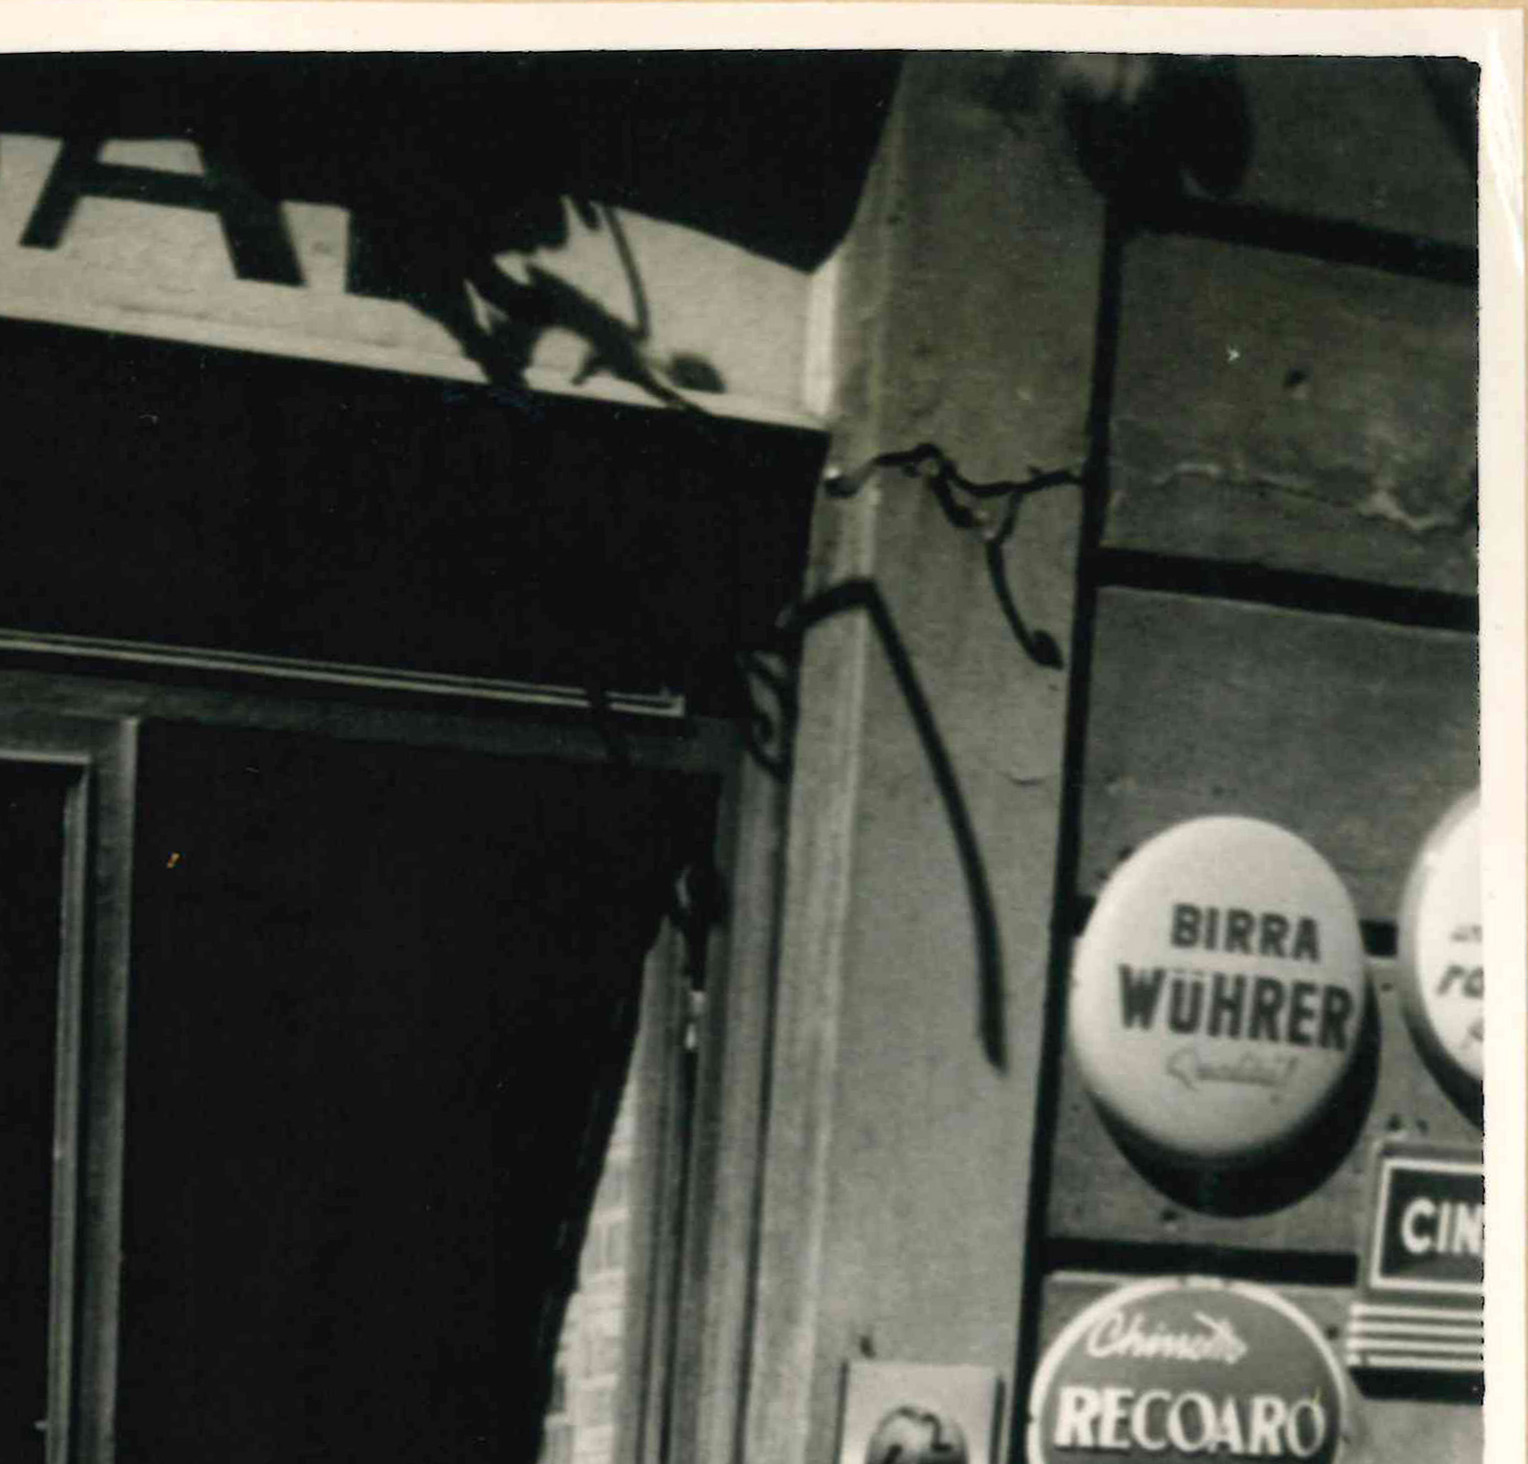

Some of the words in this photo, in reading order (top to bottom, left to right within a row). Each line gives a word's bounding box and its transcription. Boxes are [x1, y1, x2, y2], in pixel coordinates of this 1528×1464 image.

[1171, 903, 1321, 962] BIRRA
[1119, 964, 1354, 1050] WÜHRER
[1054, 1385, 1327, 1459] RECOARO
